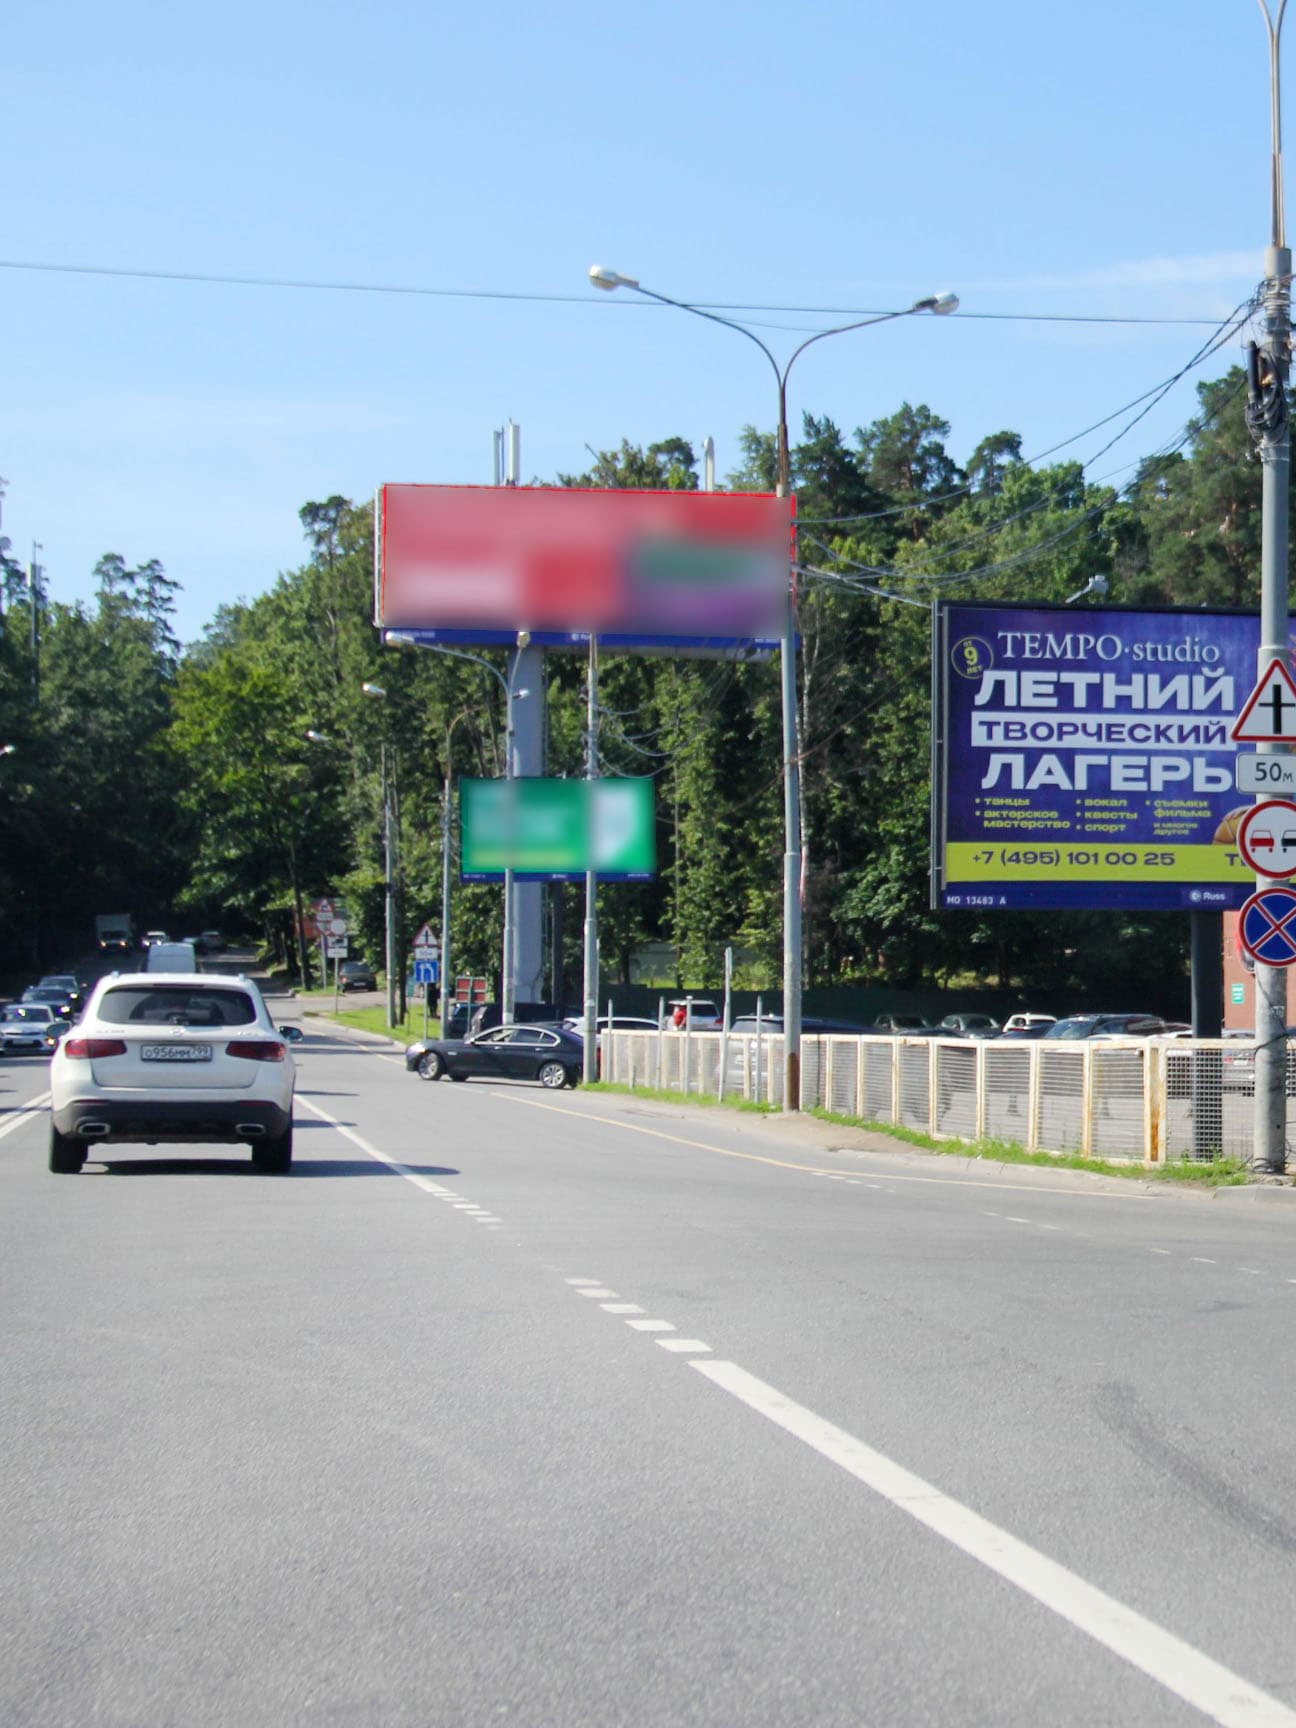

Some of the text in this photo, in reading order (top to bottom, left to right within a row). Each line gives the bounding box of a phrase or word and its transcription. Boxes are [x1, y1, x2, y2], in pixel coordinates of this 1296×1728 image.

[964, 646, 978, 666] 9
[974, 667, 1234, 711] ЛЕТНИЙ
[978, 720, 1227, 745] ТВОРЧЕСКИЙ
[981, 754, 1233, 793] ЛАГЕРЬ
[1084, 798, 1128, 807] вокал
[1084, 823, 1126, 833] спорт
[973, 849, 1176, 867] +7 (495) 101 00 25
[1203, 890, 1226, 901] Russ
